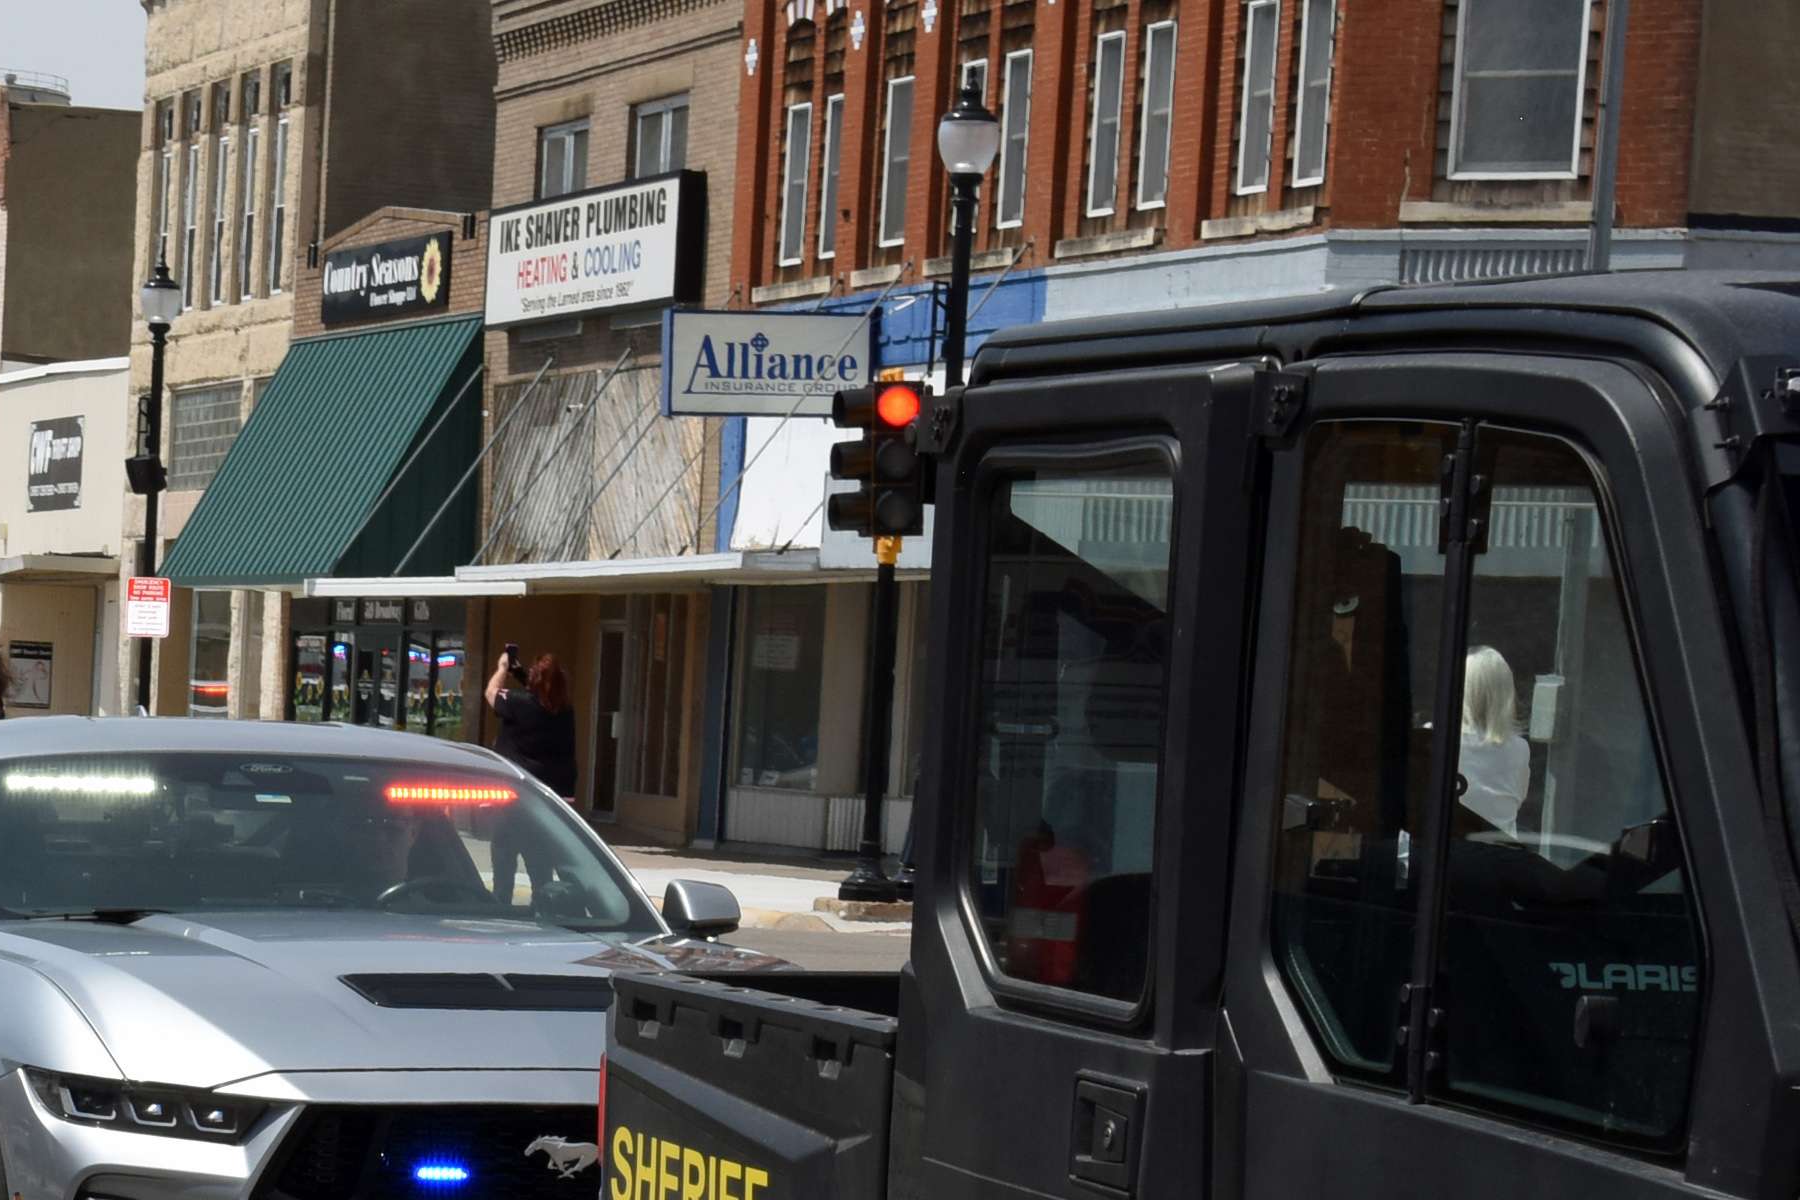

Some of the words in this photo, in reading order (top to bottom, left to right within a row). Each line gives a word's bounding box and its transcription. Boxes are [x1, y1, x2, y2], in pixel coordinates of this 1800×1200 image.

[500, 218, 521, 254] IKE
[526, 206, 580, 249] SHAVER
[586, 187, 667, 238] PLUMBING
[323, 260, 369, 296] Country
[370, 253, 419, 287] Seasons
[517, 253, 568, 290] HEATING
[572, 252, 579, 280] &
[584, 239, 642, 278] COOLING
[581, 290, 595, 303] area
[596, 284, 614, 300] since
[682, 333, 858, 394] Alliance
[705, 382, 796, 392] INSURANCE
[803, 383, 858, 392] GROUP
